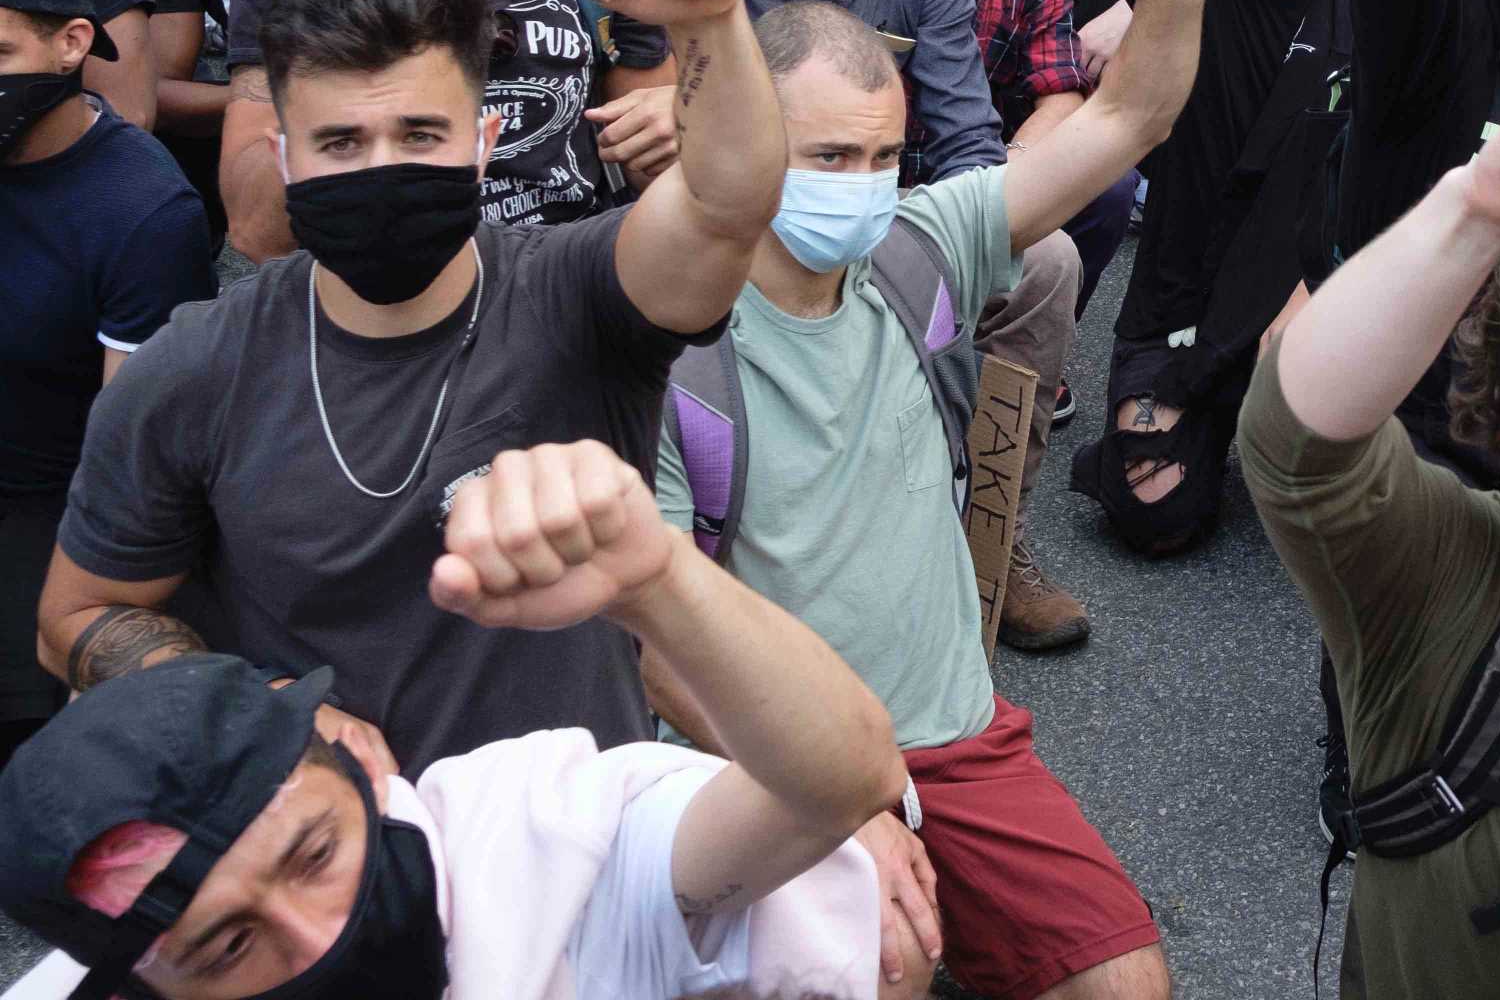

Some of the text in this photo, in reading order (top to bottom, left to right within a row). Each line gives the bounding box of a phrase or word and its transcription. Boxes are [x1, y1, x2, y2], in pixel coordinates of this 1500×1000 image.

[525, 20, 581, 60] PUB
[481, 101, 525, 119] INCE
[499, 116, 524, 135] 74
[502, 187, 543, 219] CHOICE
[543, 182, 585, 205] BREWS
[967, 386, 1023, 547] TAKE
